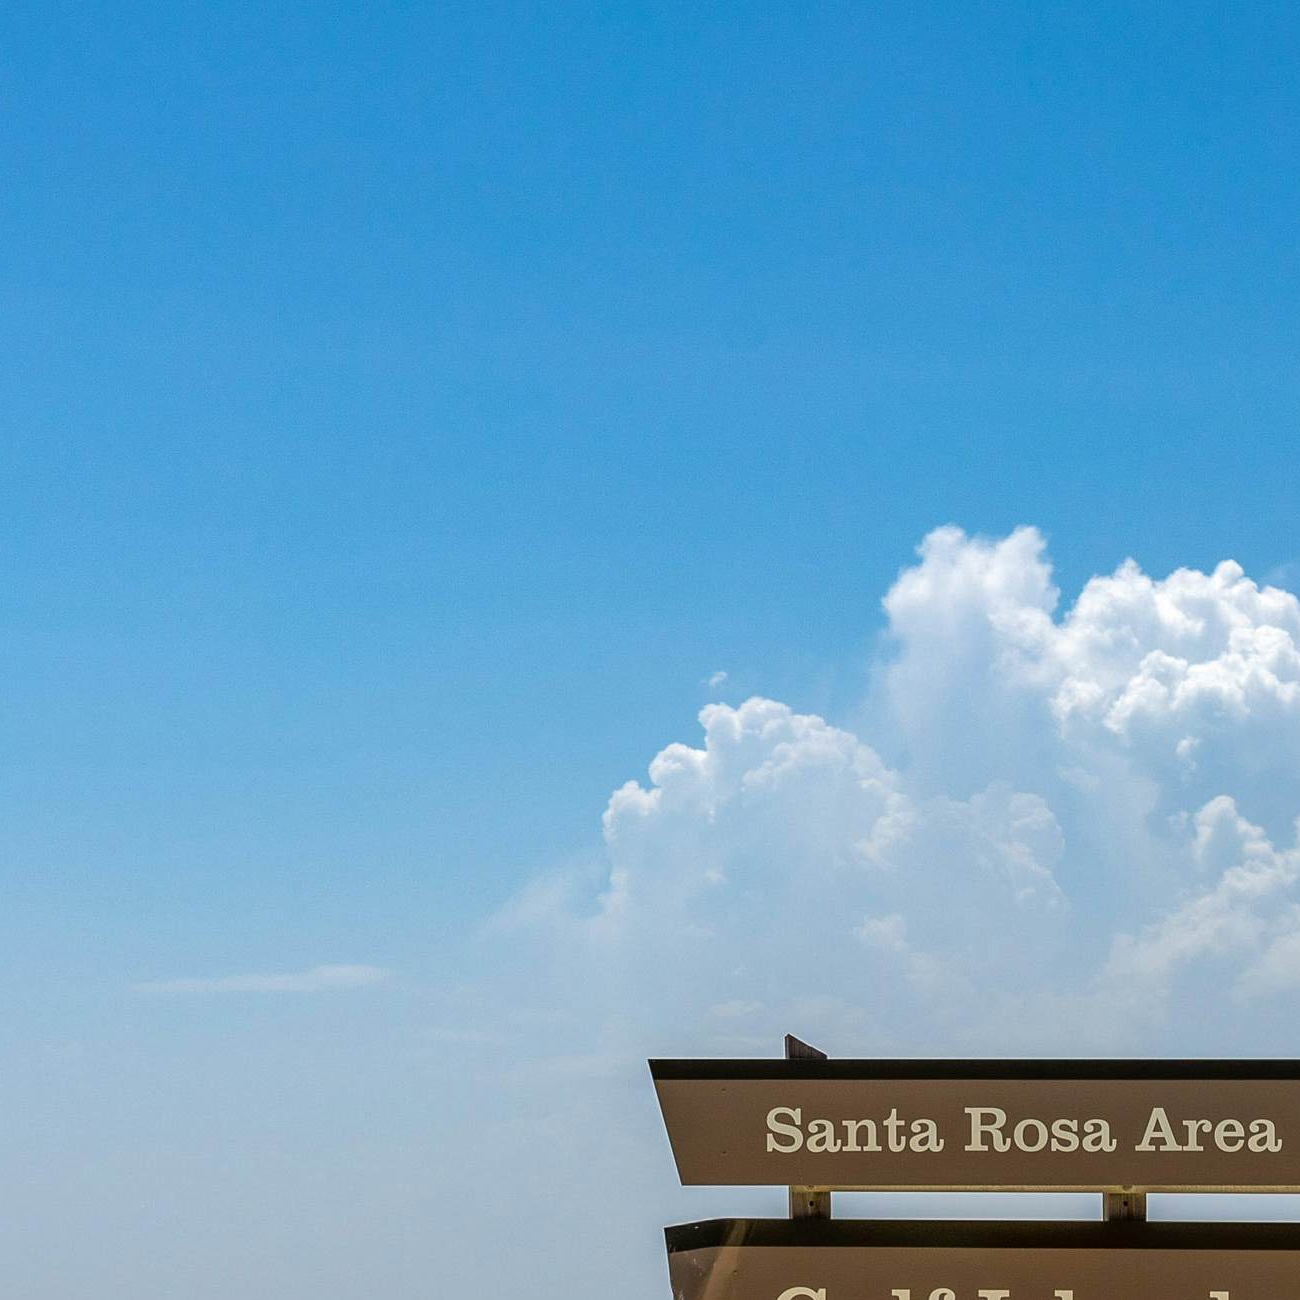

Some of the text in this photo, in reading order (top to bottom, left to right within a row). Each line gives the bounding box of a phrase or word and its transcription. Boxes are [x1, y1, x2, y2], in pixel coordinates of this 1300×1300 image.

[766, 1106, 1284, 1154] Santa Rosa Area
